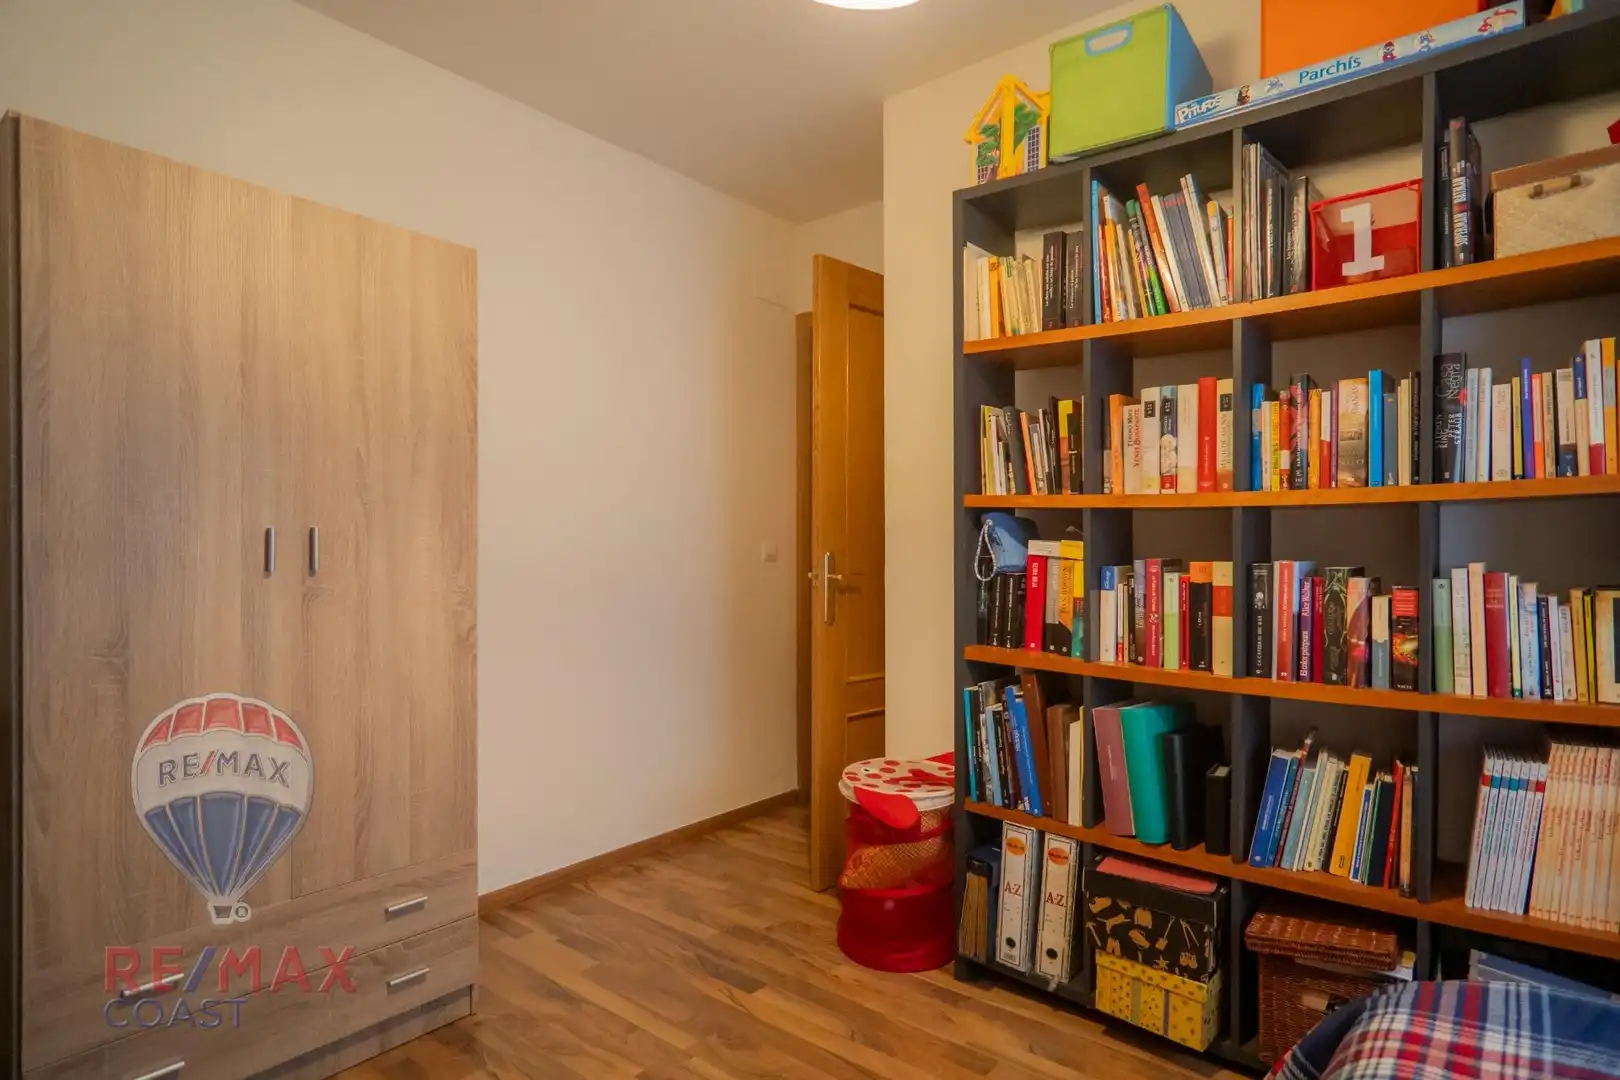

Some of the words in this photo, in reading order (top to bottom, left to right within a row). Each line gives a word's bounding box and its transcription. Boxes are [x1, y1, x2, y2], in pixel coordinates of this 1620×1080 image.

[1299, 55, 1361, 84] Parchís
[1451, 177, 1467, 204] BATMAN
[1340, 202, 1384, 276] 1
[1441, 428, 1449, 449] KING
[1448, 412, 1456, 438] PETER
